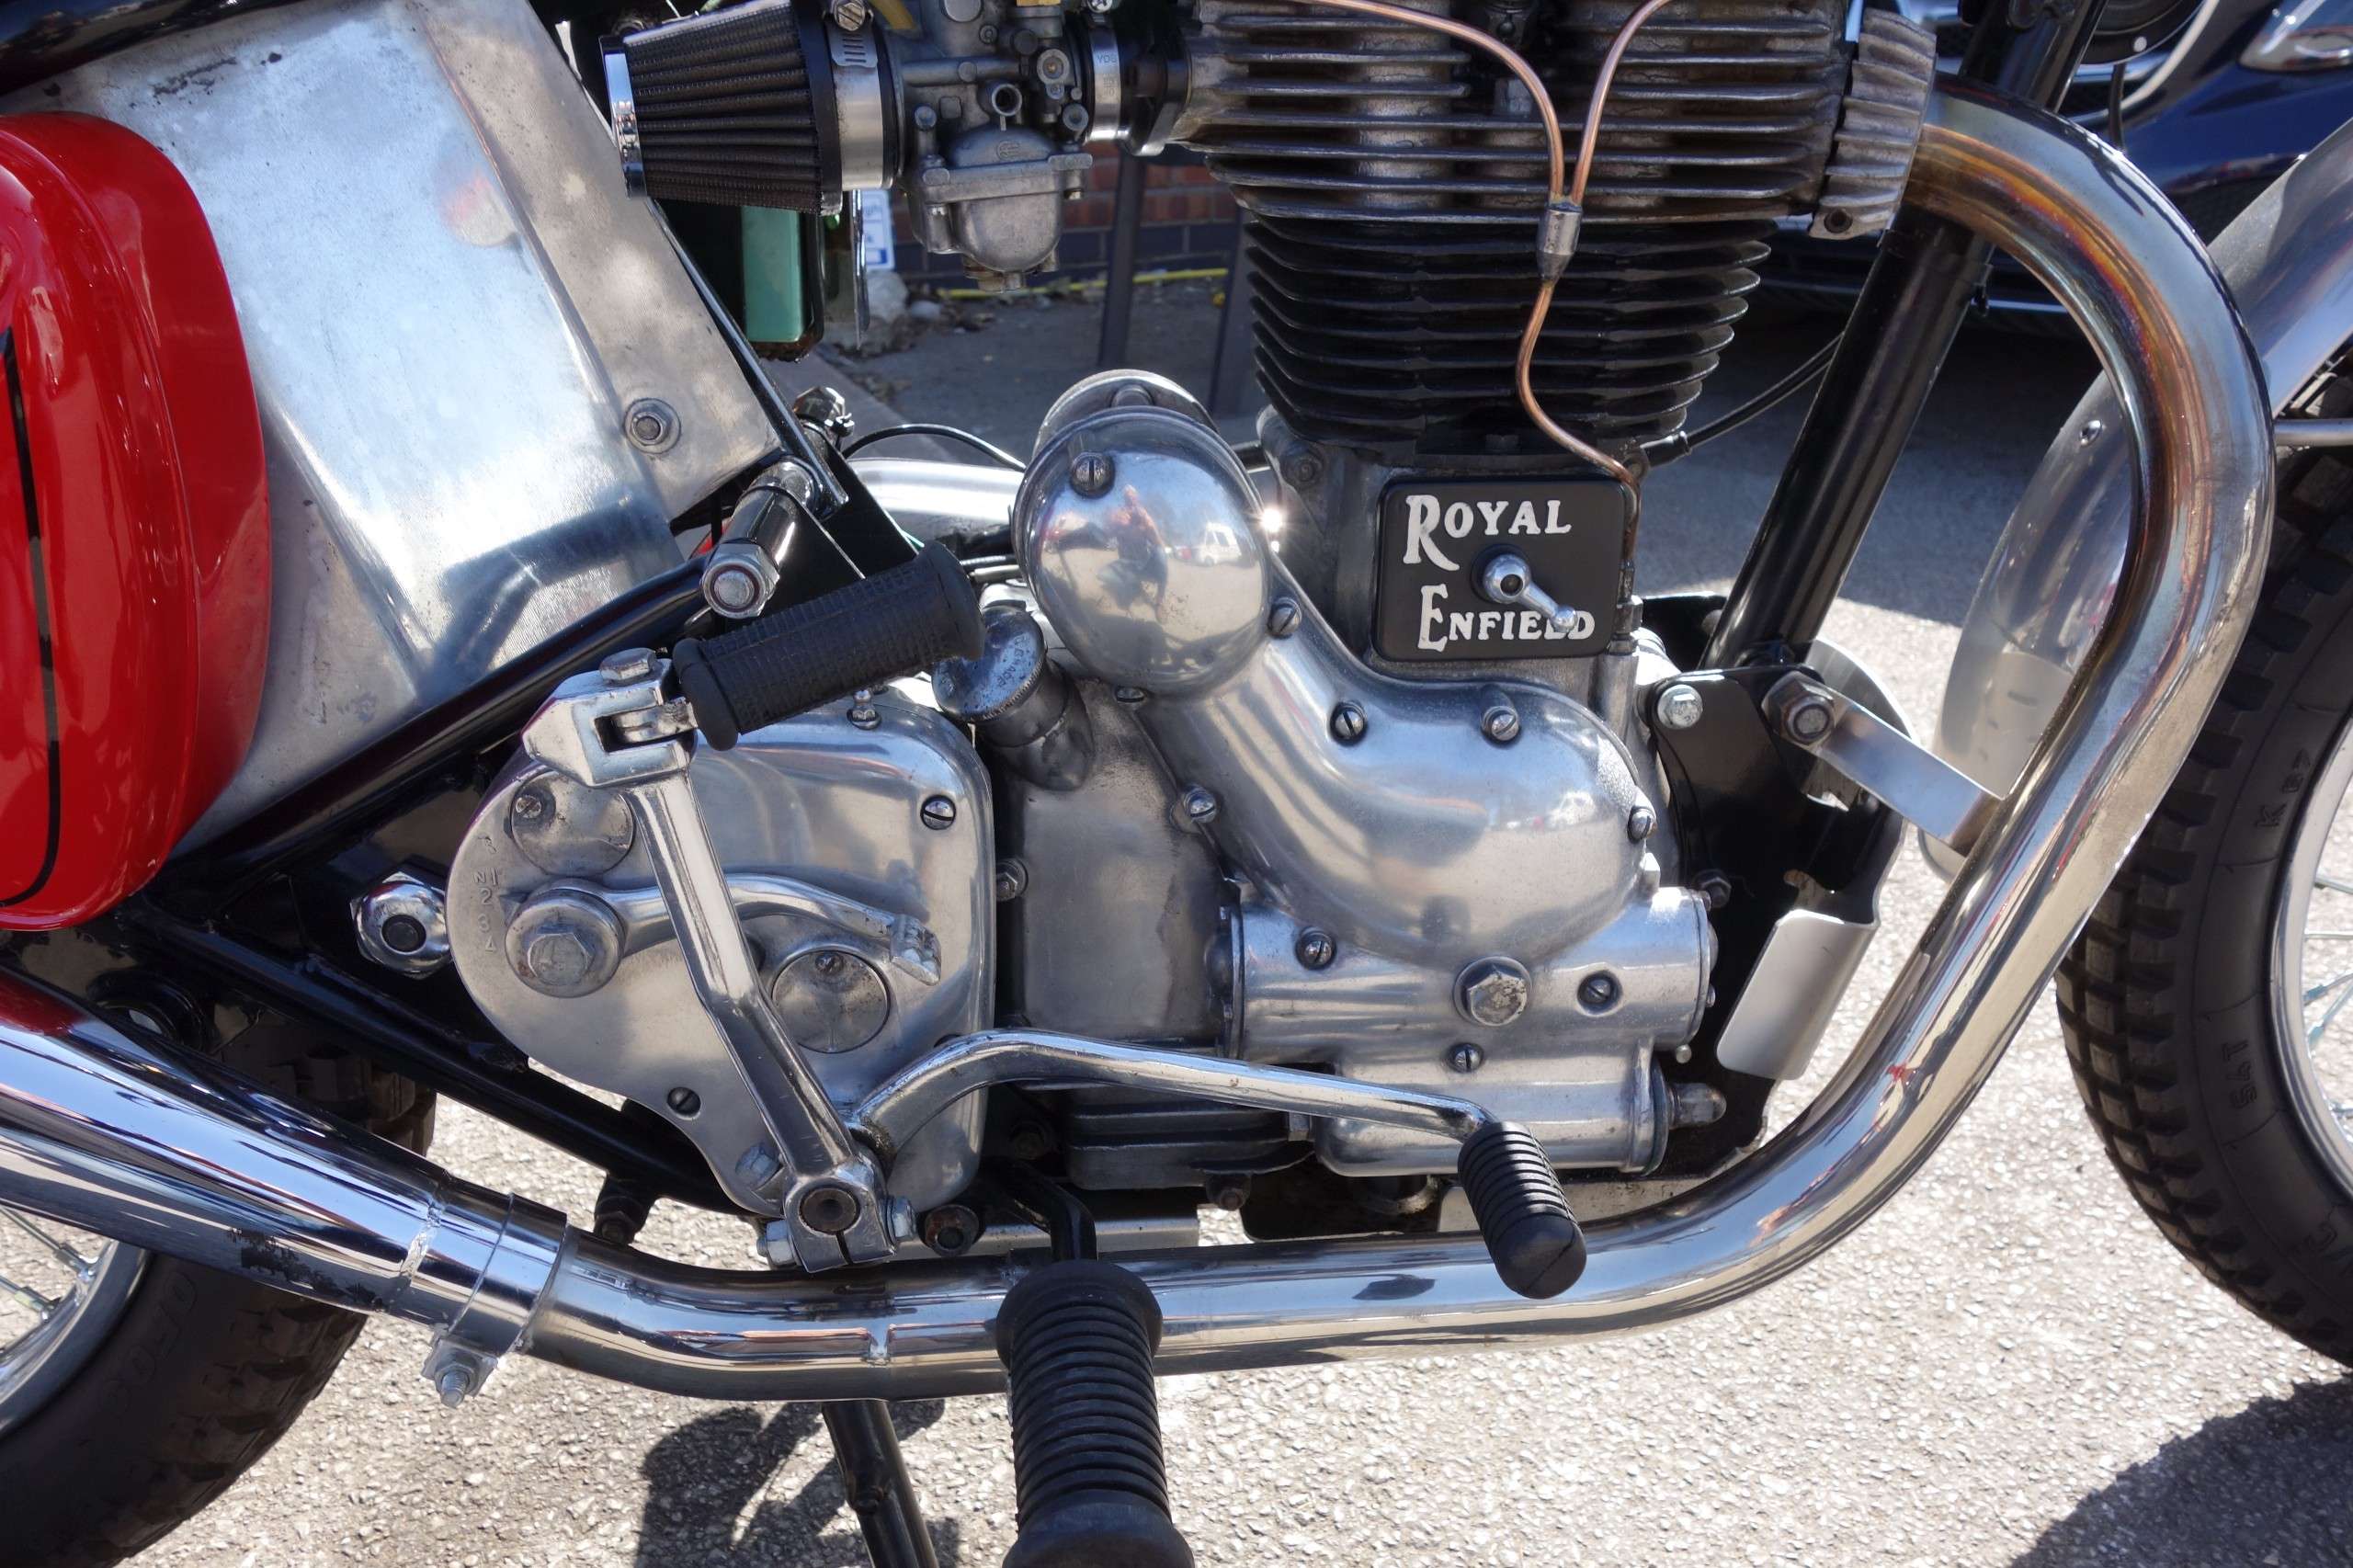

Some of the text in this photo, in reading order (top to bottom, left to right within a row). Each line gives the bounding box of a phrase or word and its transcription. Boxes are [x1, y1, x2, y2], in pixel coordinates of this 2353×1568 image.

[1403, 494, 1572, 572] ROYAL
[479, 887, 494, 905] 2
[478, 914, 492, 934] 3
